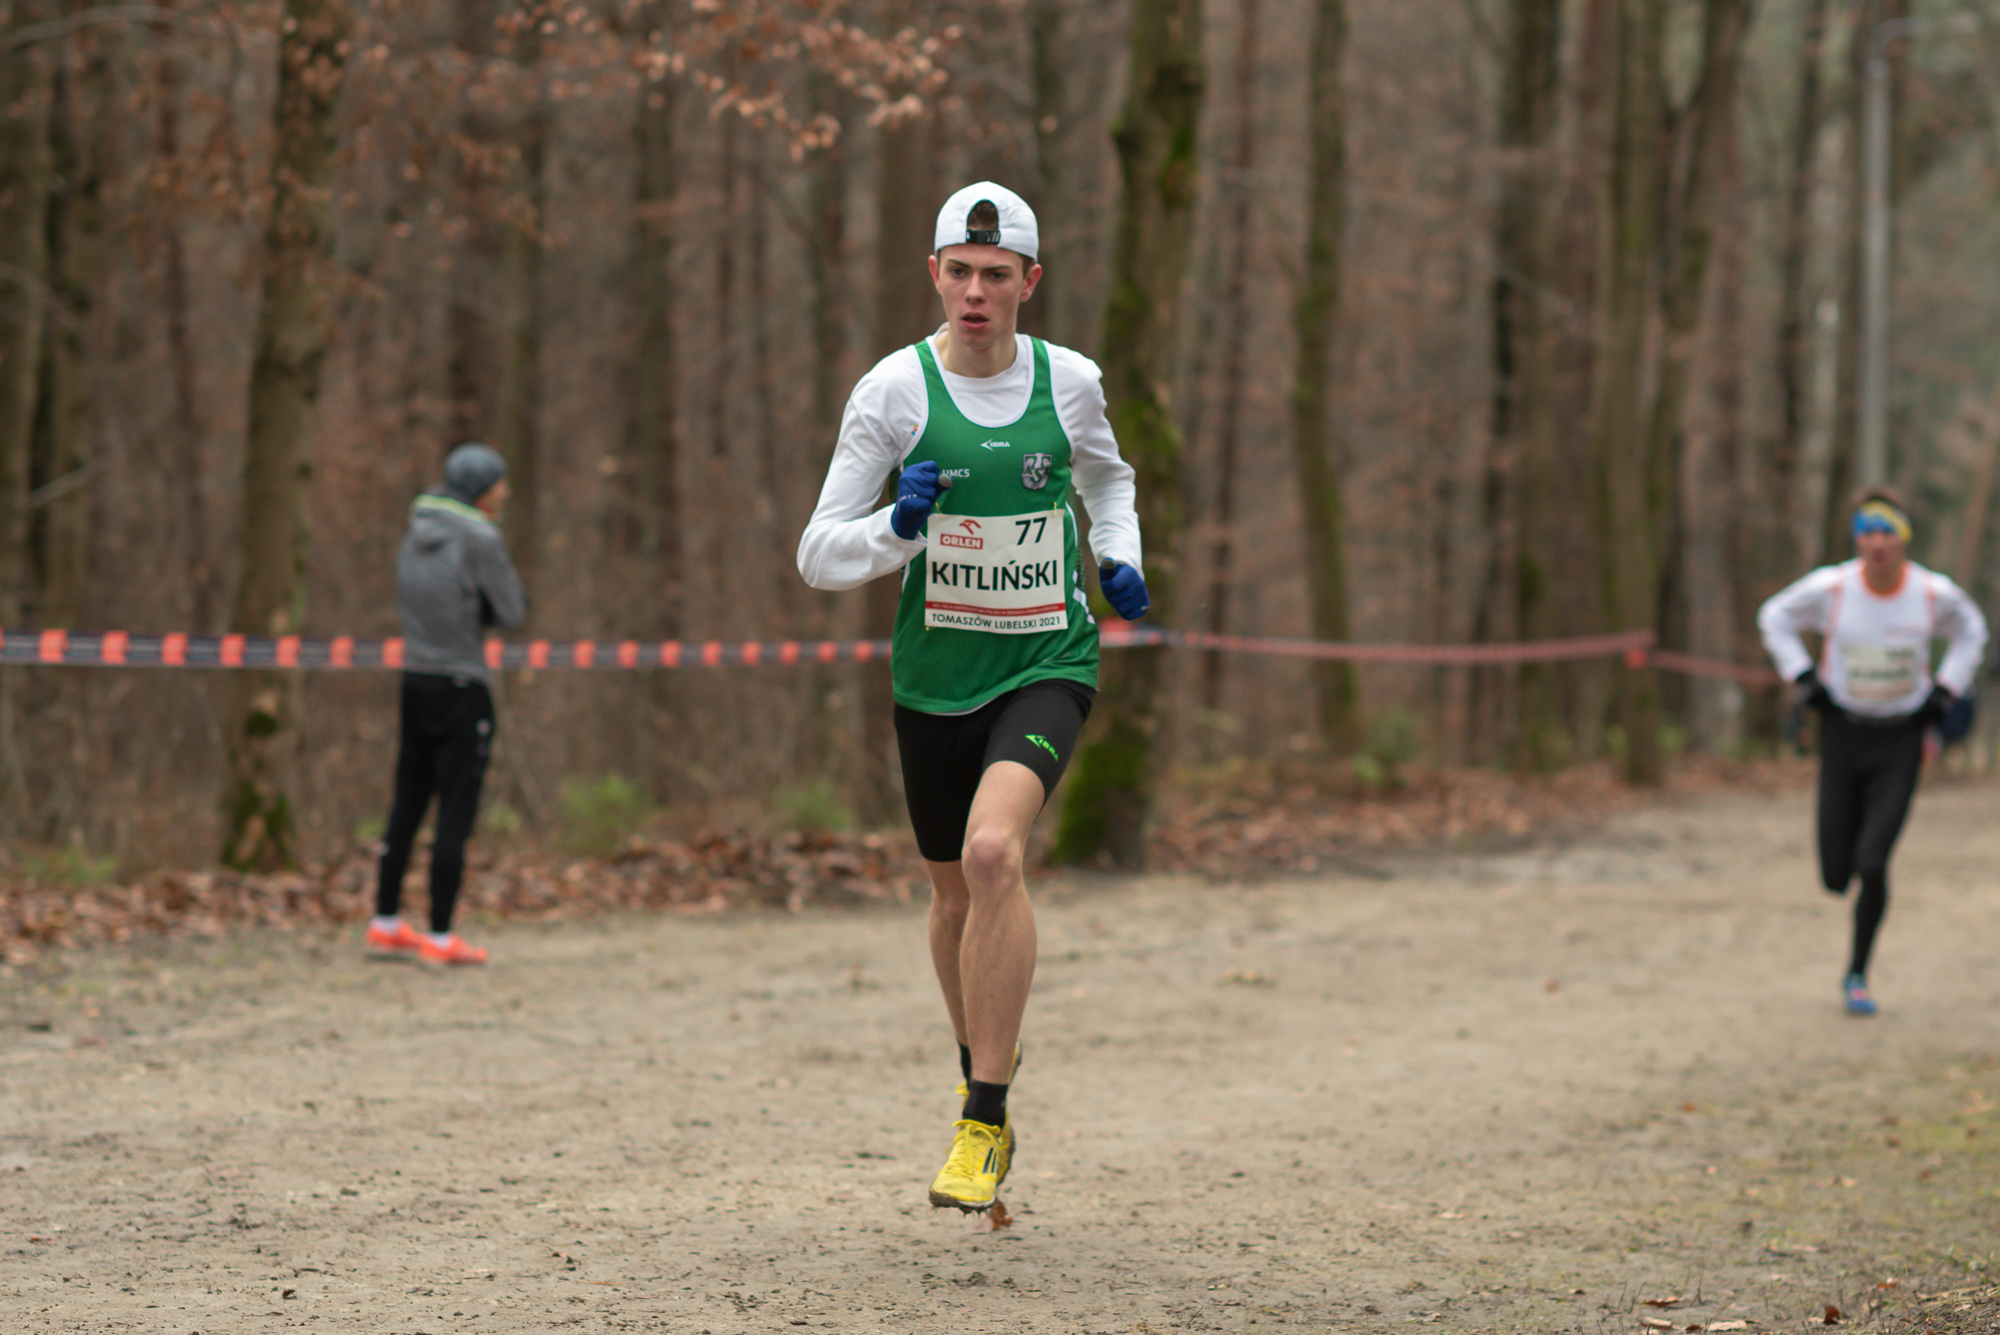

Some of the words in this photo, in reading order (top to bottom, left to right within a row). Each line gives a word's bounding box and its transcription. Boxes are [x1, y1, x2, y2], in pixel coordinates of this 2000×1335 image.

[942, 535, 981, 548] ORLEN
[1015, 516, 1047, 546] 77
[931, 560, 1057, 591] KITLIŃSKI
[932, 613, 992, 628] TOMASZÓW
[994, 619, 1037, 630] LUBELSKI
[1039, 616, 1060, 627] 2021
